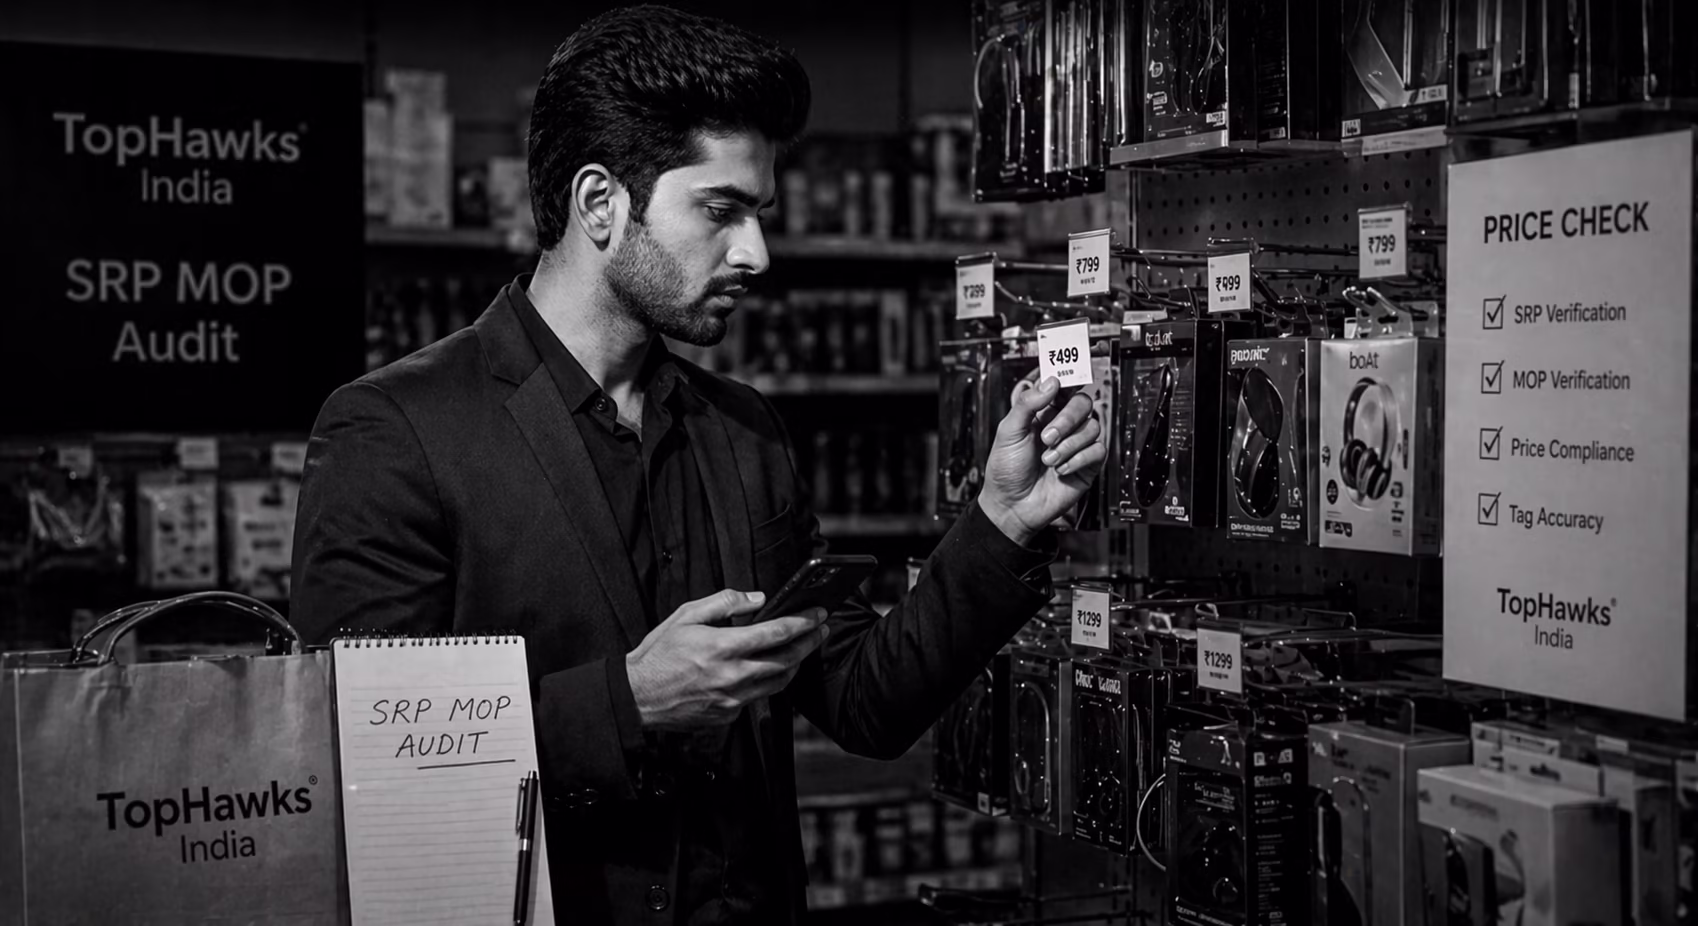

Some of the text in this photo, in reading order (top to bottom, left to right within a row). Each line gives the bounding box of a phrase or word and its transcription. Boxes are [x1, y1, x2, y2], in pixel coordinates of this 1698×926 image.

[142, 169, 233, 206] India
[1484, 201, 1649, 243] PRICE CHECK
[1076, 256, 1100, 275] ₹799
[66, 259, 292, 305] SRP MOP
[1514, 302, 1627, 325] SRP Verification
[112, 320, 240, 362] Audit
[1048, 346, 1079, 367] ₹499
[1349, 351, 1380, 371] boAt
[1513, 369, 1631, 390] MOP Verification
[1511, 437, 1635, 465] Price Compliance
[1508, 504, 1604, 535] Tag Accuracy
[1534, 624, 1574, 650] India
[369, 695, 511, 726] SRP MOP
[394, 730, 489, 759] AUDIT
[180, 829, 256, 864] India
